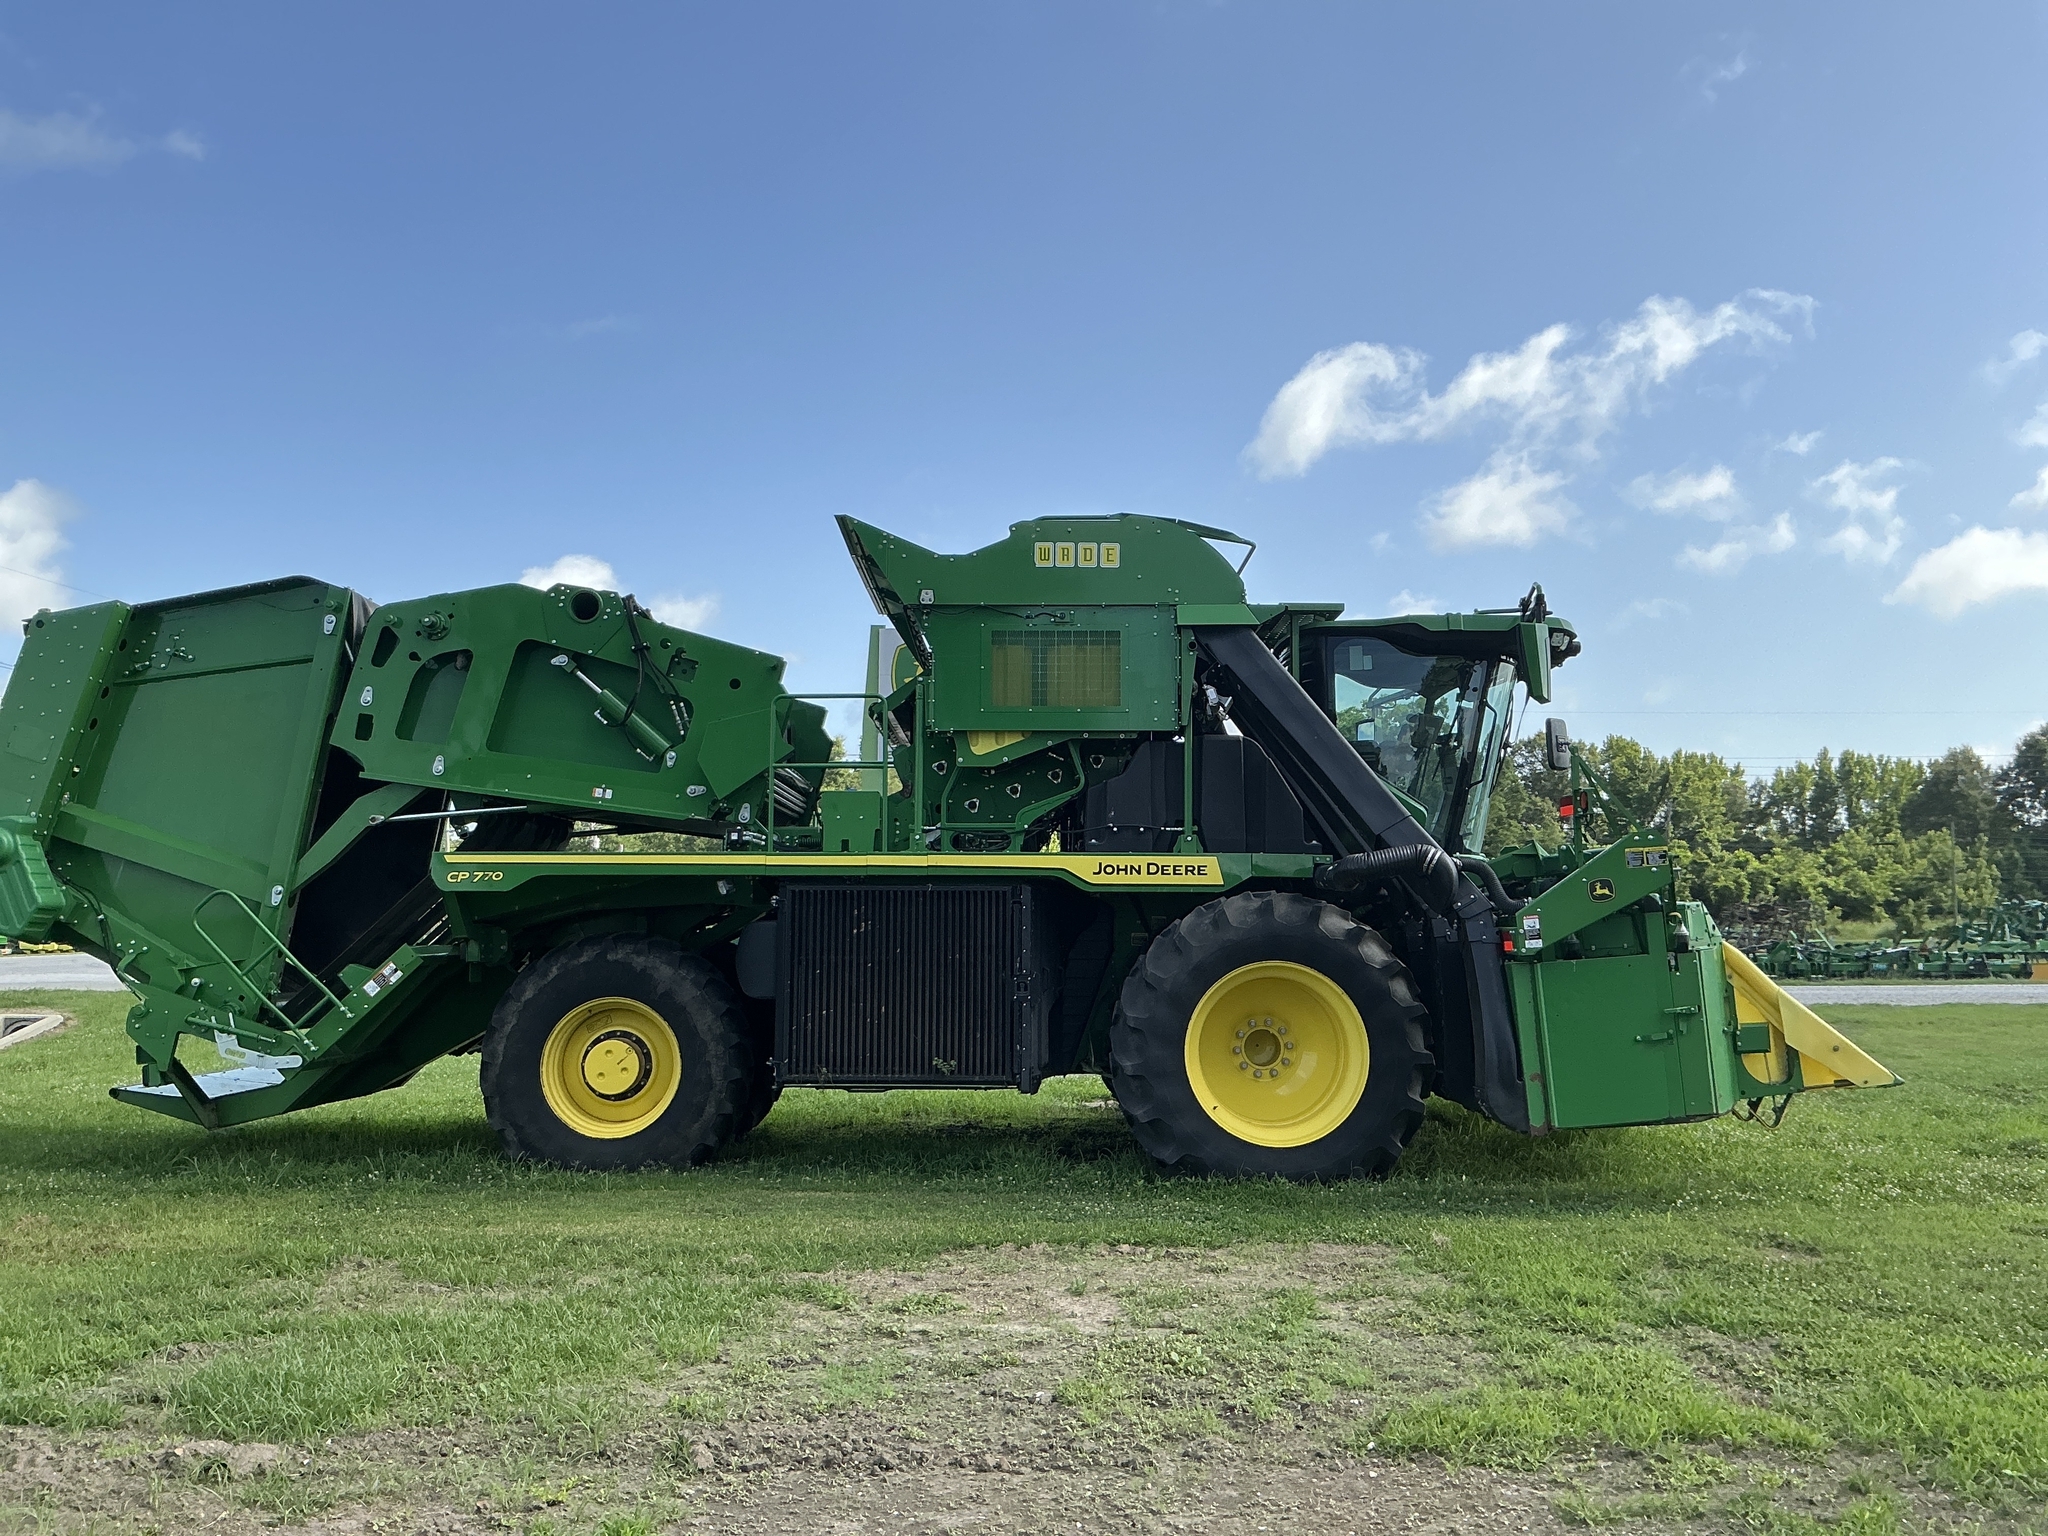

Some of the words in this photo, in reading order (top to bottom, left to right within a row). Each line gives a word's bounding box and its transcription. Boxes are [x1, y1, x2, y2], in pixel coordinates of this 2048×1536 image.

[1038, 546, 1116, 563] WADE
[1092, 862, 1142, 876] JOHN
[1146, 862, 1208, 876] DEERE
[472, 871, 504, 883] 770
